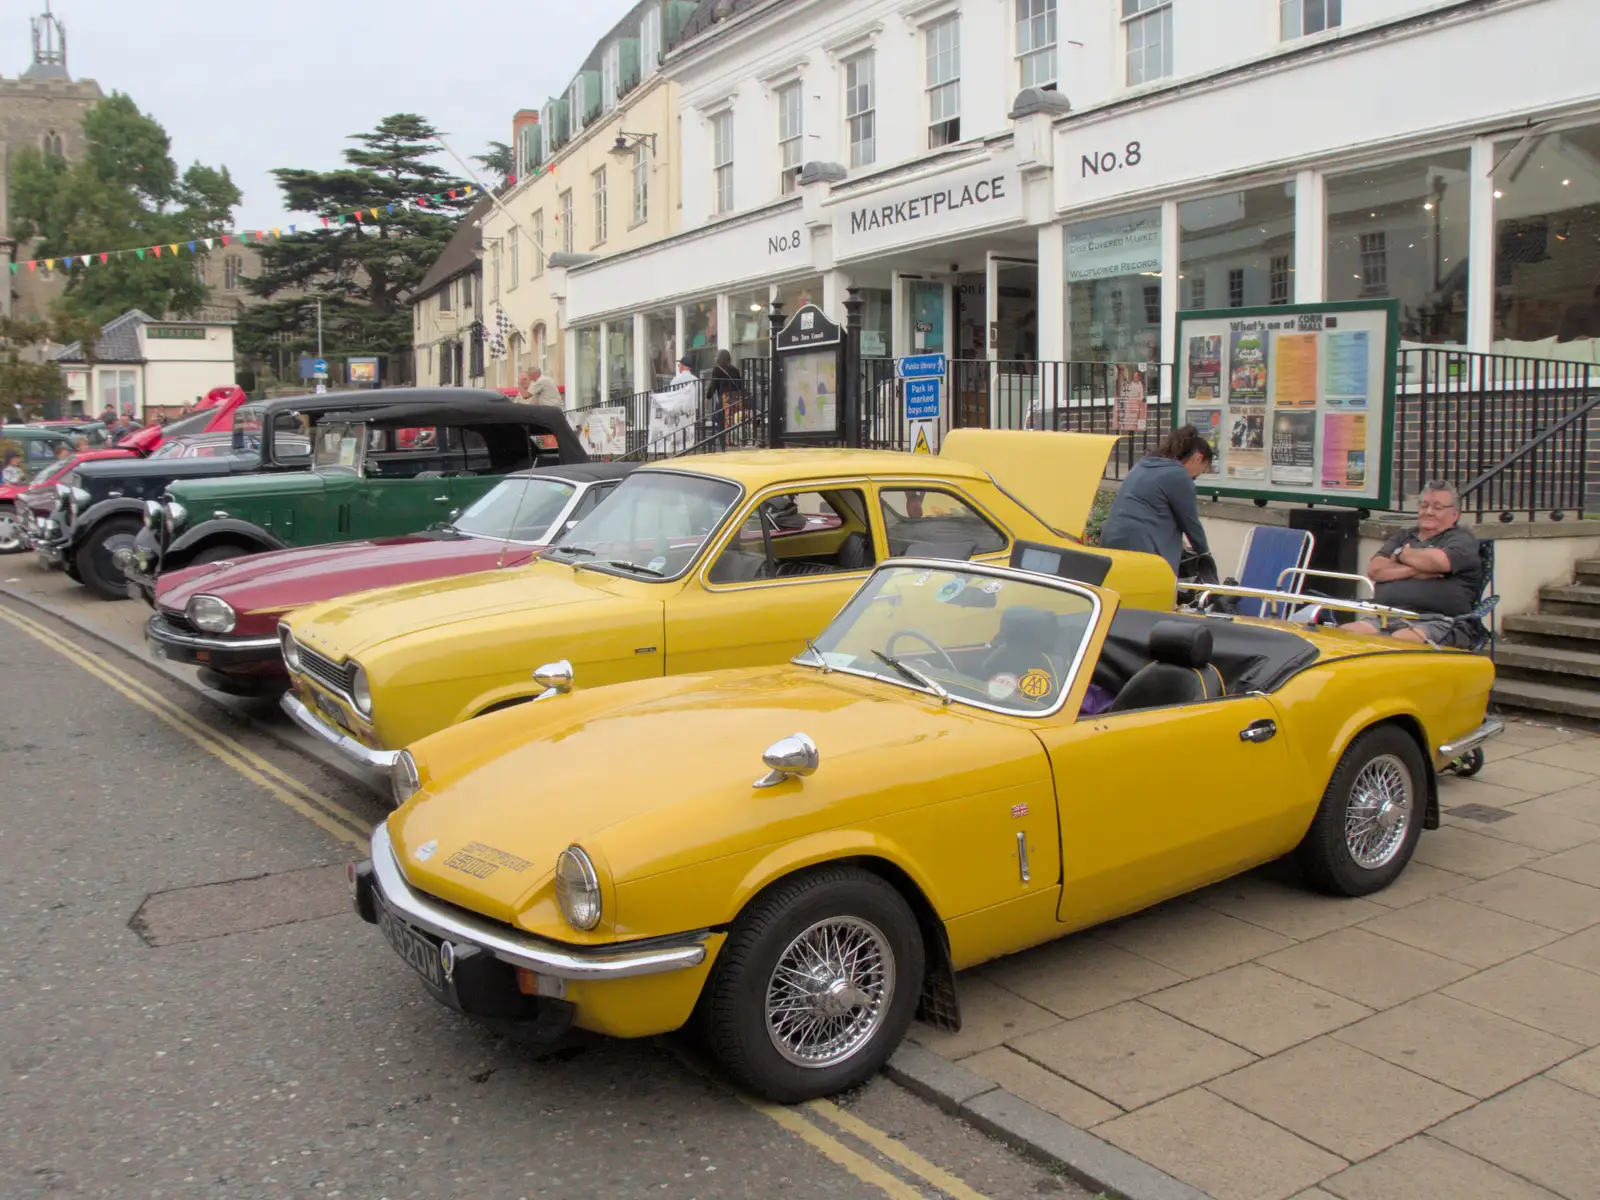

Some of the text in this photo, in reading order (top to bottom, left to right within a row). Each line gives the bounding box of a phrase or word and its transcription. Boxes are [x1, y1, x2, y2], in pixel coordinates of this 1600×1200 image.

[851, 176, 1005, 235] MARKETPLACE
[1088, 238, 1124, 251] COVERED
[1125, 232, 1158, 244] MARKET
[1070, 259, 1159, 279] WILDFLOWER RECORDS
[1230, 320, 1265, 331] What's
[1268, 322, 1280, 330] on
[1284, 319, 1295, 329] at
[905, 362, 920, 370] Public
[911, 383, 934, 393] Park in
[911, 394, 934, 404] marked
[908, 404, 937, 416] bays only
[443, 851, 500, 879] 1500
